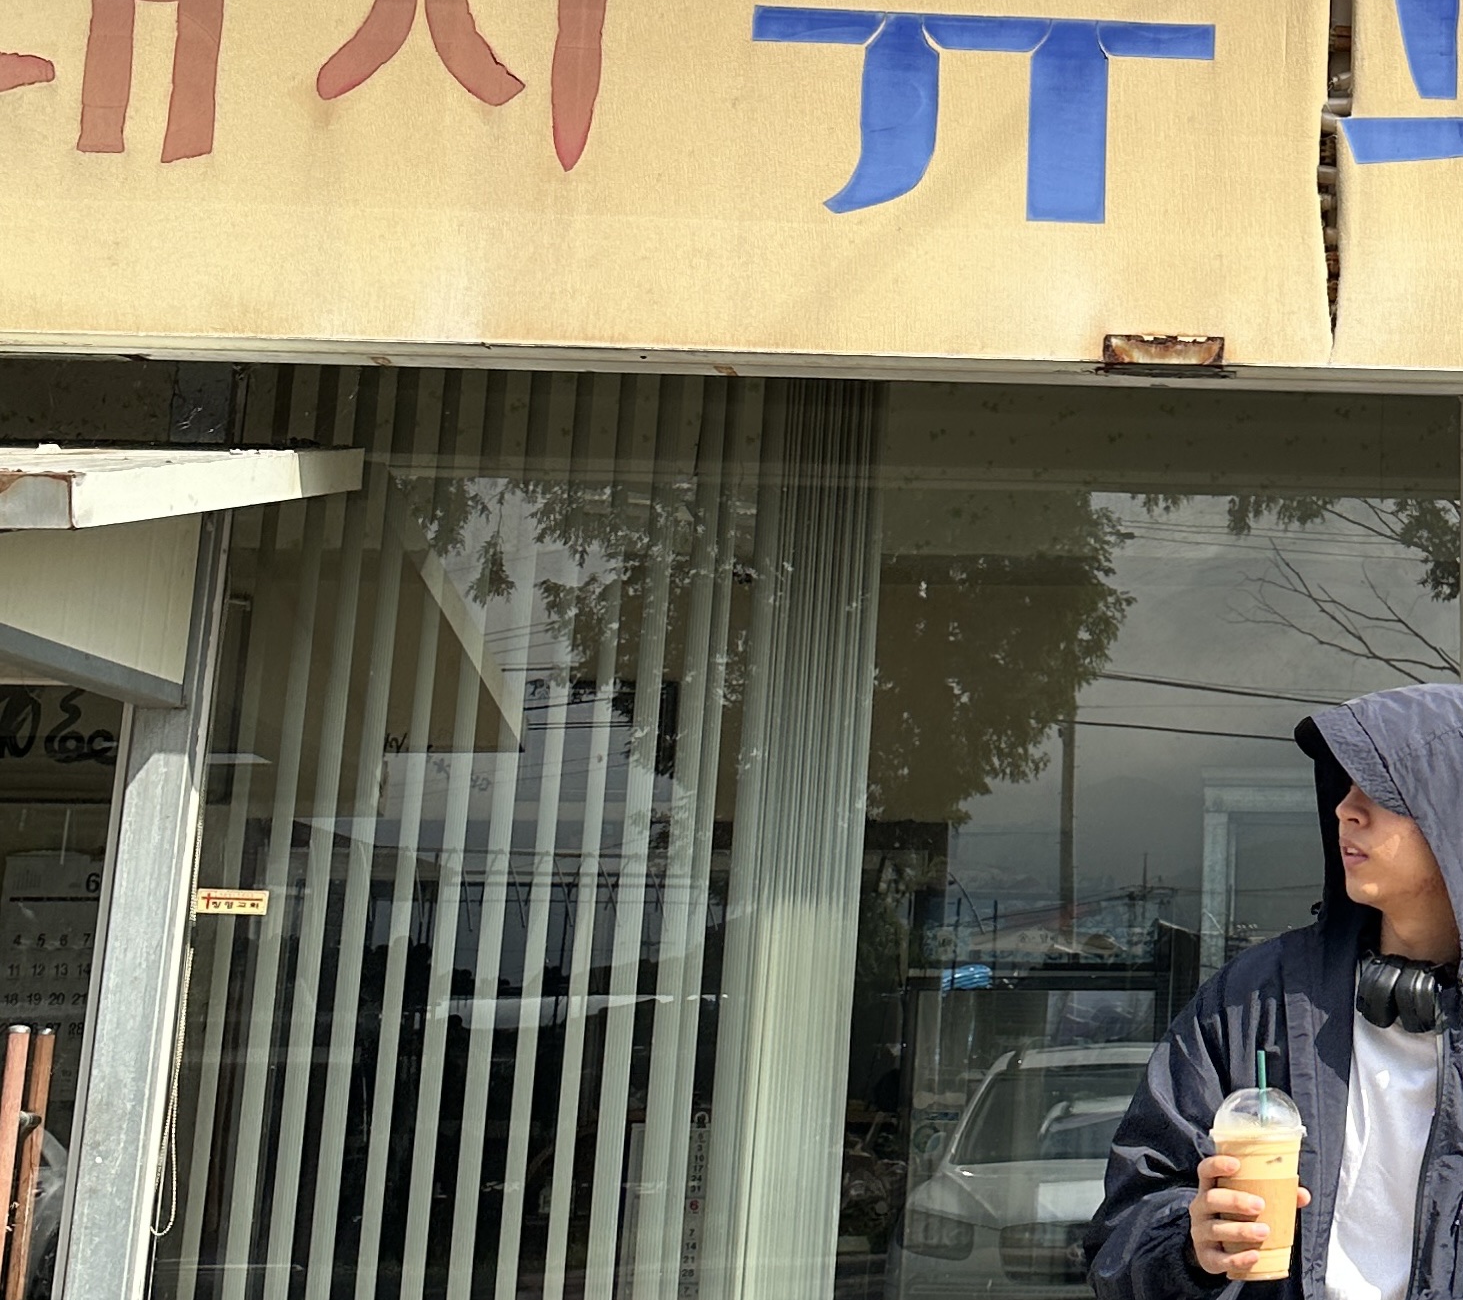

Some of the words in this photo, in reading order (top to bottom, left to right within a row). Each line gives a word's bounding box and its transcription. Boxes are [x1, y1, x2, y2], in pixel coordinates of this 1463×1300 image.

[85, 872, 101, 893] 6
[36, 933, 46, 948] 5
[83, 932, 92, 946] 7
[8, 963, 20, 976] 11
[32, 963, 45, 976] 12
[54, 963, 68, 976] 13
[4, 992, 19, 1006] 18
[27, 992, 42, 1006] 19
[48, 992, 66, 1006] 20
[71, 992, 88, 1006] 21
